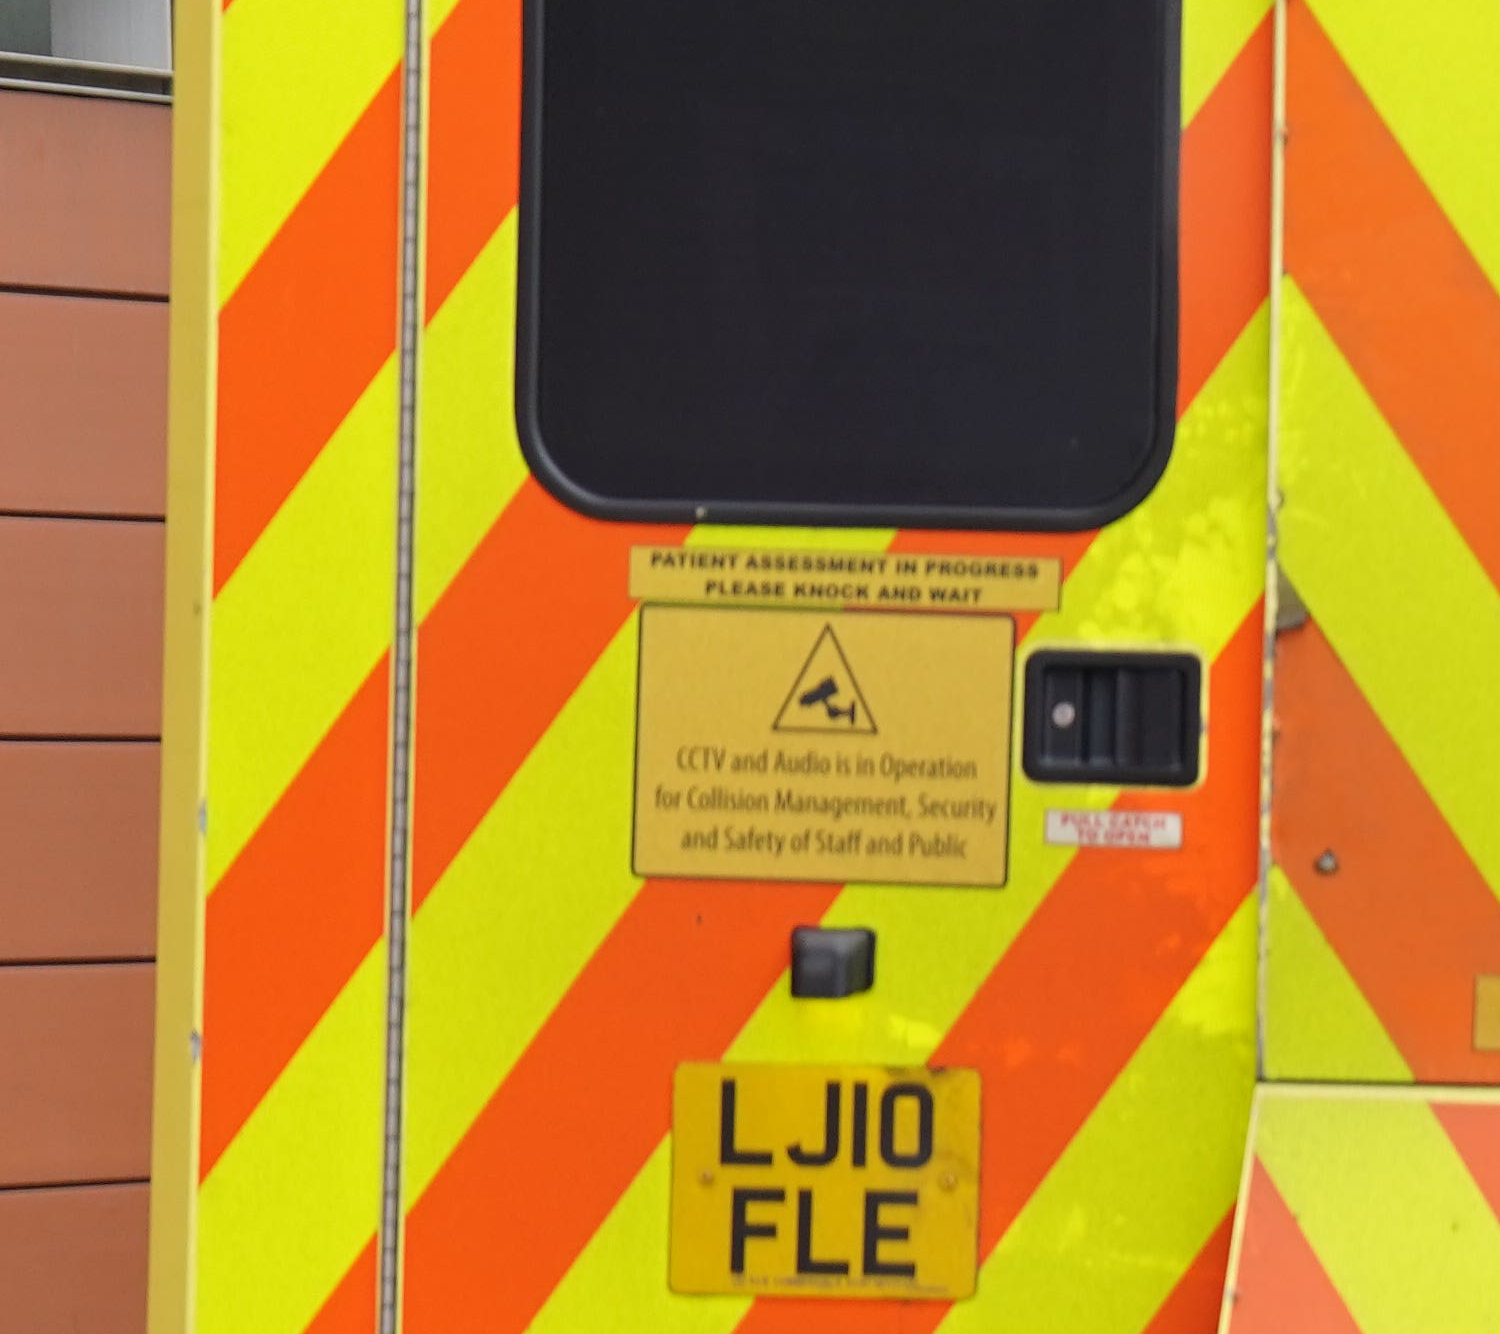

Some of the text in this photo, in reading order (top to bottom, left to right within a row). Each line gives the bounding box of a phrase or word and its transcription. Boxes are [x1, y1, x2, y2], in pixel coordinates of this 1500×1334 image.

[650, 551, 1039, 580] PATIENT ASSESSMENT IN PROGRESS
[705, 580, 983, 605] PLEASE KNOCK AND WAIT
[676, 746, 979, 784] CCTV and Audio is in Operation
[654, 784, 998, 825] for Collision Management, Security
[680, 826, 968, 860] and Safety of Staff and Public
[719, 1078, 935, 1169] LJ10
[730, 1188, 920, 1279] FLE
